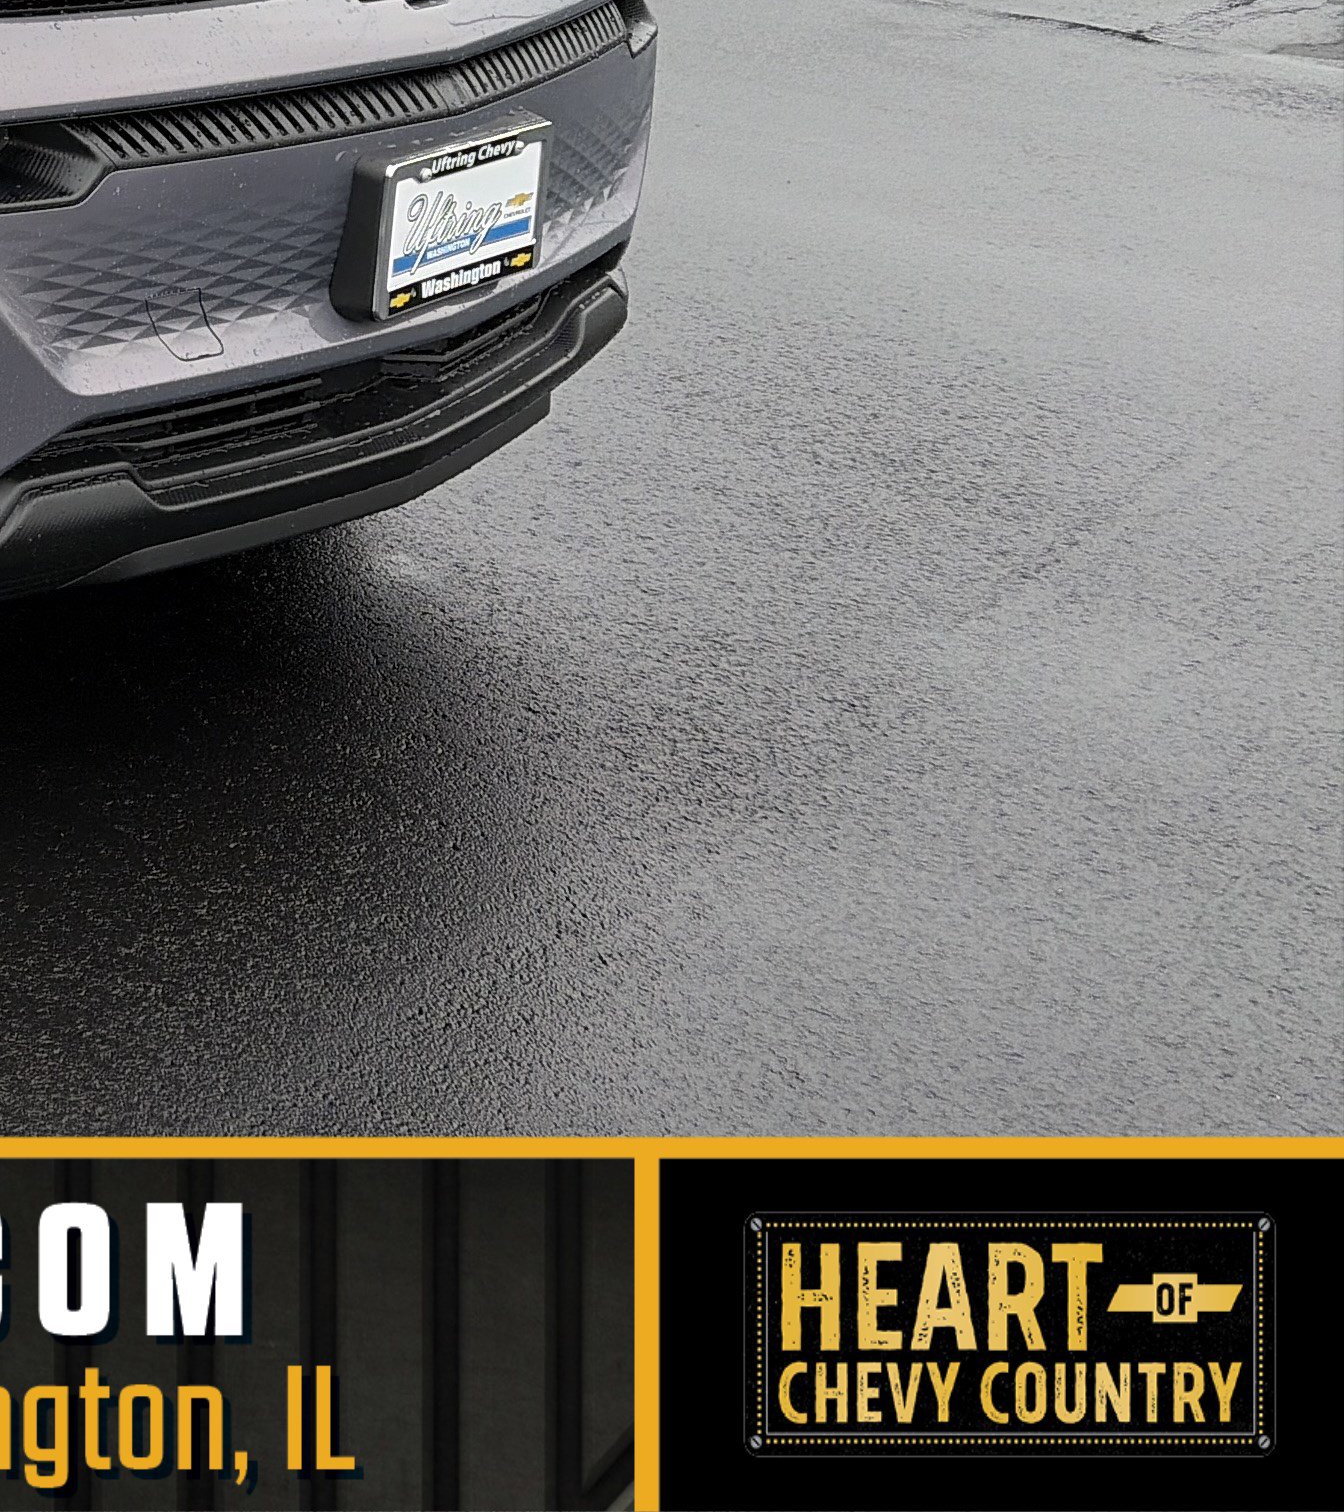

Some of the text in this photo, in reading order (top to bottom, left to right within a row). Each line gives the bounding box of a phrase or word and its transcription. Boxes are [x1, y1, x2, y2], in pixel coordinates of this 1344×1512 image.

[431, 140, 516, 175] Uftring Chevy
[403, 191, 503, 275] Uftring
[426, 238, 471, 260] WASHINGTON
[421, 260, 501, 299] Washington
